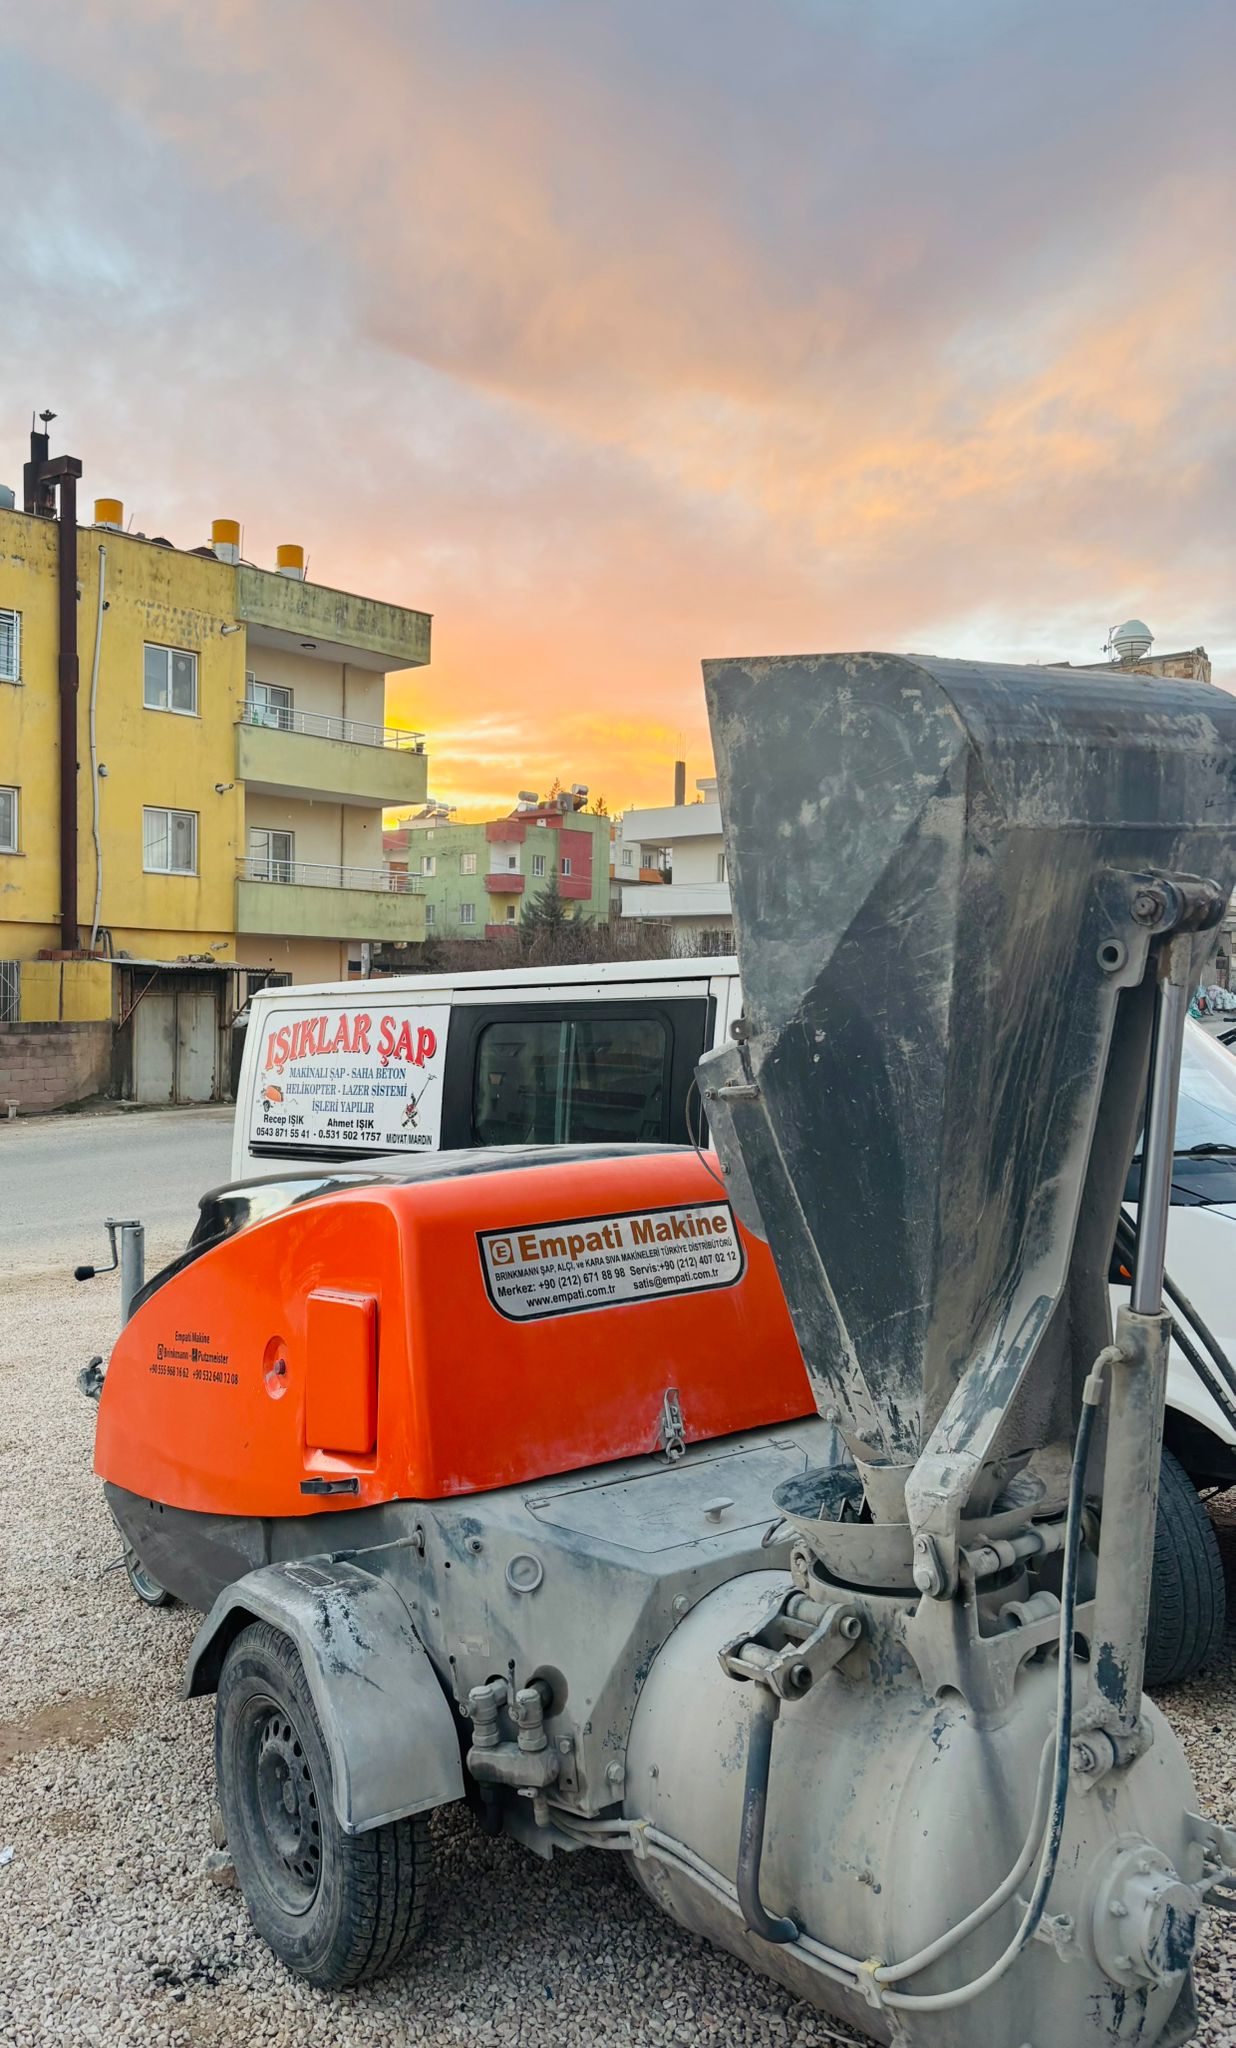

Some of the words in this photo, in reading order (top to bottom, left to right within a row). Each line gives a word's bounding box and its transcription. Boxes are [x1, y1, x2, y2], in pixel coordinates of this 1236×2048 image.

[265, 1013, 372, 1074] IŞIKLAR
[289, 1065, 328, 1078] MAKİNALI
[330, 1068, 345, 1081] ŞAP
[352, 1067, 373, 1078] SAHA
[376, 1067, 406, 1079] BETON
[286, 1081, 336, 1095] HELİKOPTER
[342, 1084, 369, 1096] LAZER
[371, 1083, 408, 1097] SİSTEMİ
[312, 1098, 338, 1113] İŞLERİ
[341, 1101, 374, 1114] YAPILIR
[264, 1114, 286, 1126] Recep
[288, 1115, 304, 1127] IŞIK
[327, 1118, 353, 1128] Ahmet
[356, 1119, 374, 1130] IŞIK
[257, 1127, 273, 1137] 0543
[275, 1128, 288, 1137] 871
[290, 1129, 299, 1138] 55
[301, 1129, 310, 1138] 41
[343, 1131, 358, 1140] 502
[360, 1132, 381, 1141] 1757
[518, 1223, 623, 1262] Empati
[630, 1214, 728, 1245] Makine
[540, 1264, 556, 1275] ŞAP,
[585, 1257, 606, 1267] KARA
[606, 1255, 620, 1264] SIVA
[621, 1247, 660, 1262] MAKİNELERİ
[661, 1244, 688, 1256] TÜRKİYE
[689, 1237, 732, 1252] DİSTRİBÜTÖRÜ
[497, 1283, 536, 1297] Merkez:
[538, 1279, 555, 1290] +90
[558, 1274, 581, 1289] (212)
[583, 1272, 599, 1283] 671
[602, 1270, 612, 1280] 88
[614, 1268, 625, 1278] 98
[677, 1256, 697, 1271] (212)
[699, 1254, 714, 1265] 407
[715, 1253, 725, 1262] 02
[727, 1251, 736, 1260] 12
[527, 1284, 615, 1307] www.empati.com.tr
[633, 1268, 718, 1290] satis@empati.com.tr
